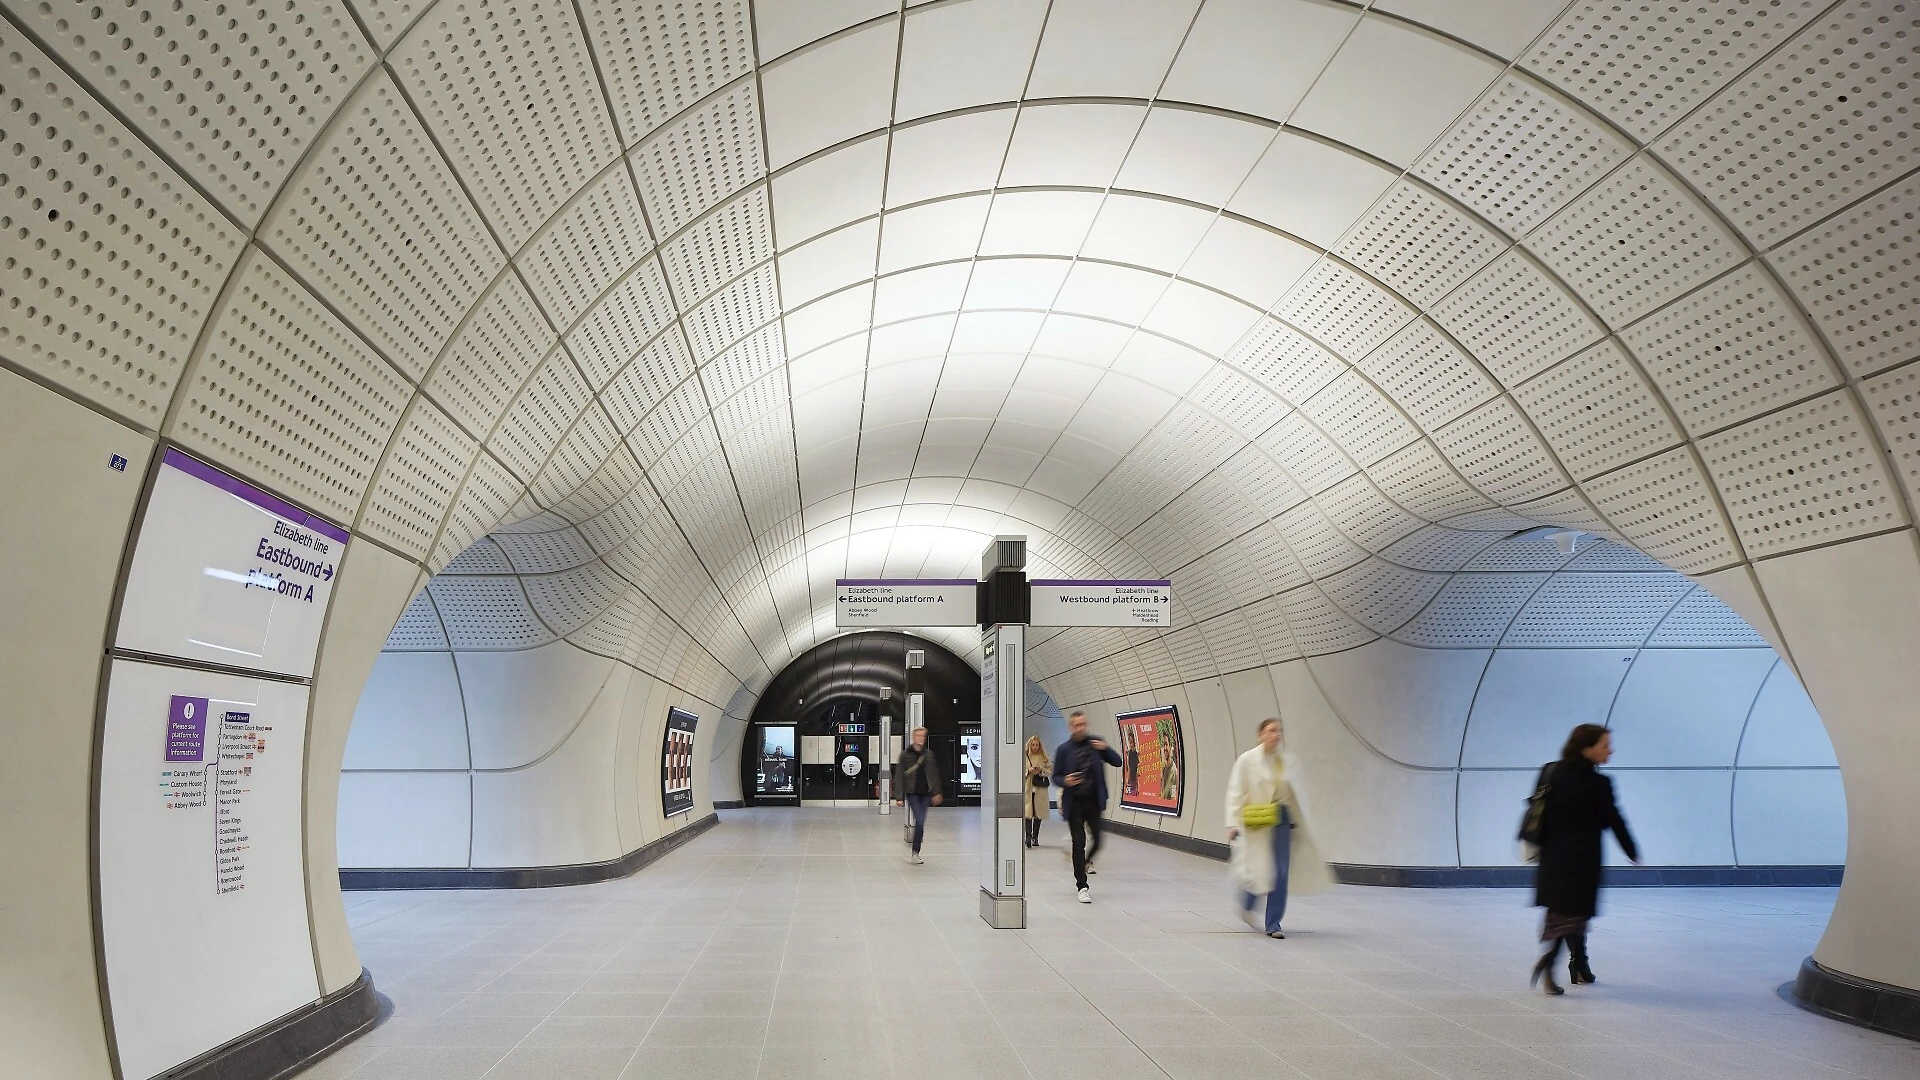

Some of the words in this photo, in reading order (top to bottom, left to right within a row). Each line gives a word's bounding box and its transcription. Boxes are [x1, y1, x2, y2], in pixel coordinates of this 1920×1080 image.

[274, 520, 312, 548] Elizabeth
[313, 538, 328, 554] line
[256, 538, 322, 578] Eastbound
[245, 568, 302, 600] platform
[304, 585, 314, 603] A
[896, 595, 935, 604] platform
[1112, 596, 1151, 604] platform
